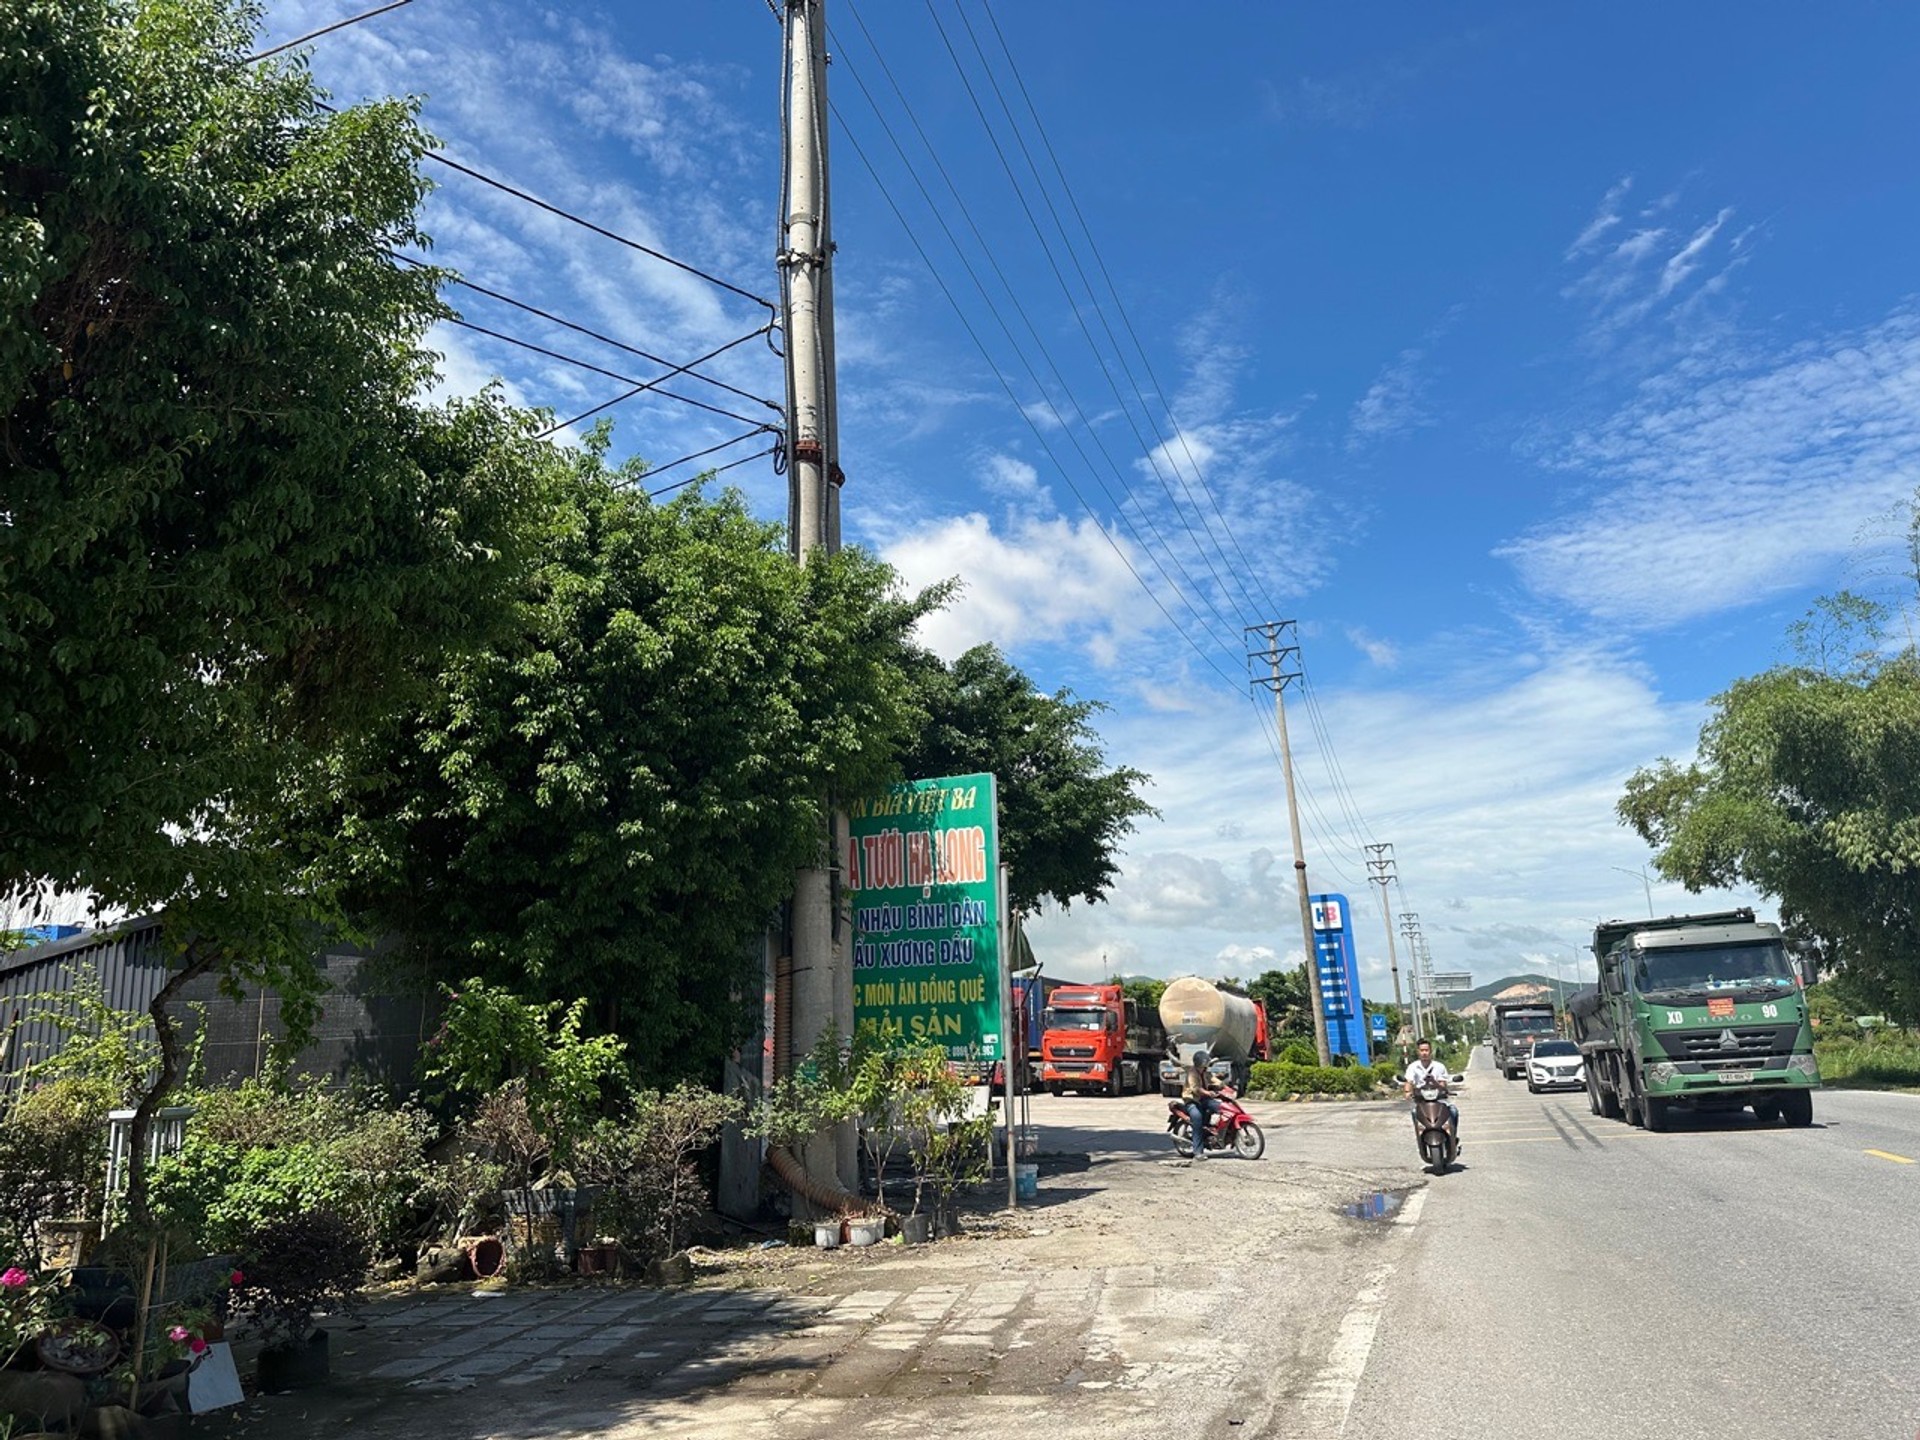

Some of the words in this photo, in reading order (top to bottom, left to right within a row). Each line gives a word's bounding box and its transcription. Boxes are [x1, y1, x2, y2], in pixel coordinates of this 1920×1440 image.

[907, 830, 933, 898] HẠ
[935, 826, 986, 884] LONG
[858, 902, 902, 937] NHẬU
[906, 899, 947, 931] BÌNH
[951, 896, 987, 928] DÂN
[1315, 906, 1338, 922] HB
[879, 938, 936, 969] XƯƠNG
[865, 978, 895, 1006] MÓN
[898, 977, 917, 1005] ĂN
[920, 973, 956, 1005] ĐỒNG
[960, 974, 985, 1005] QUÊ
[910, 1007, 962, 1037] SẢN
[1762, 1004, 1778, 1018] 90
